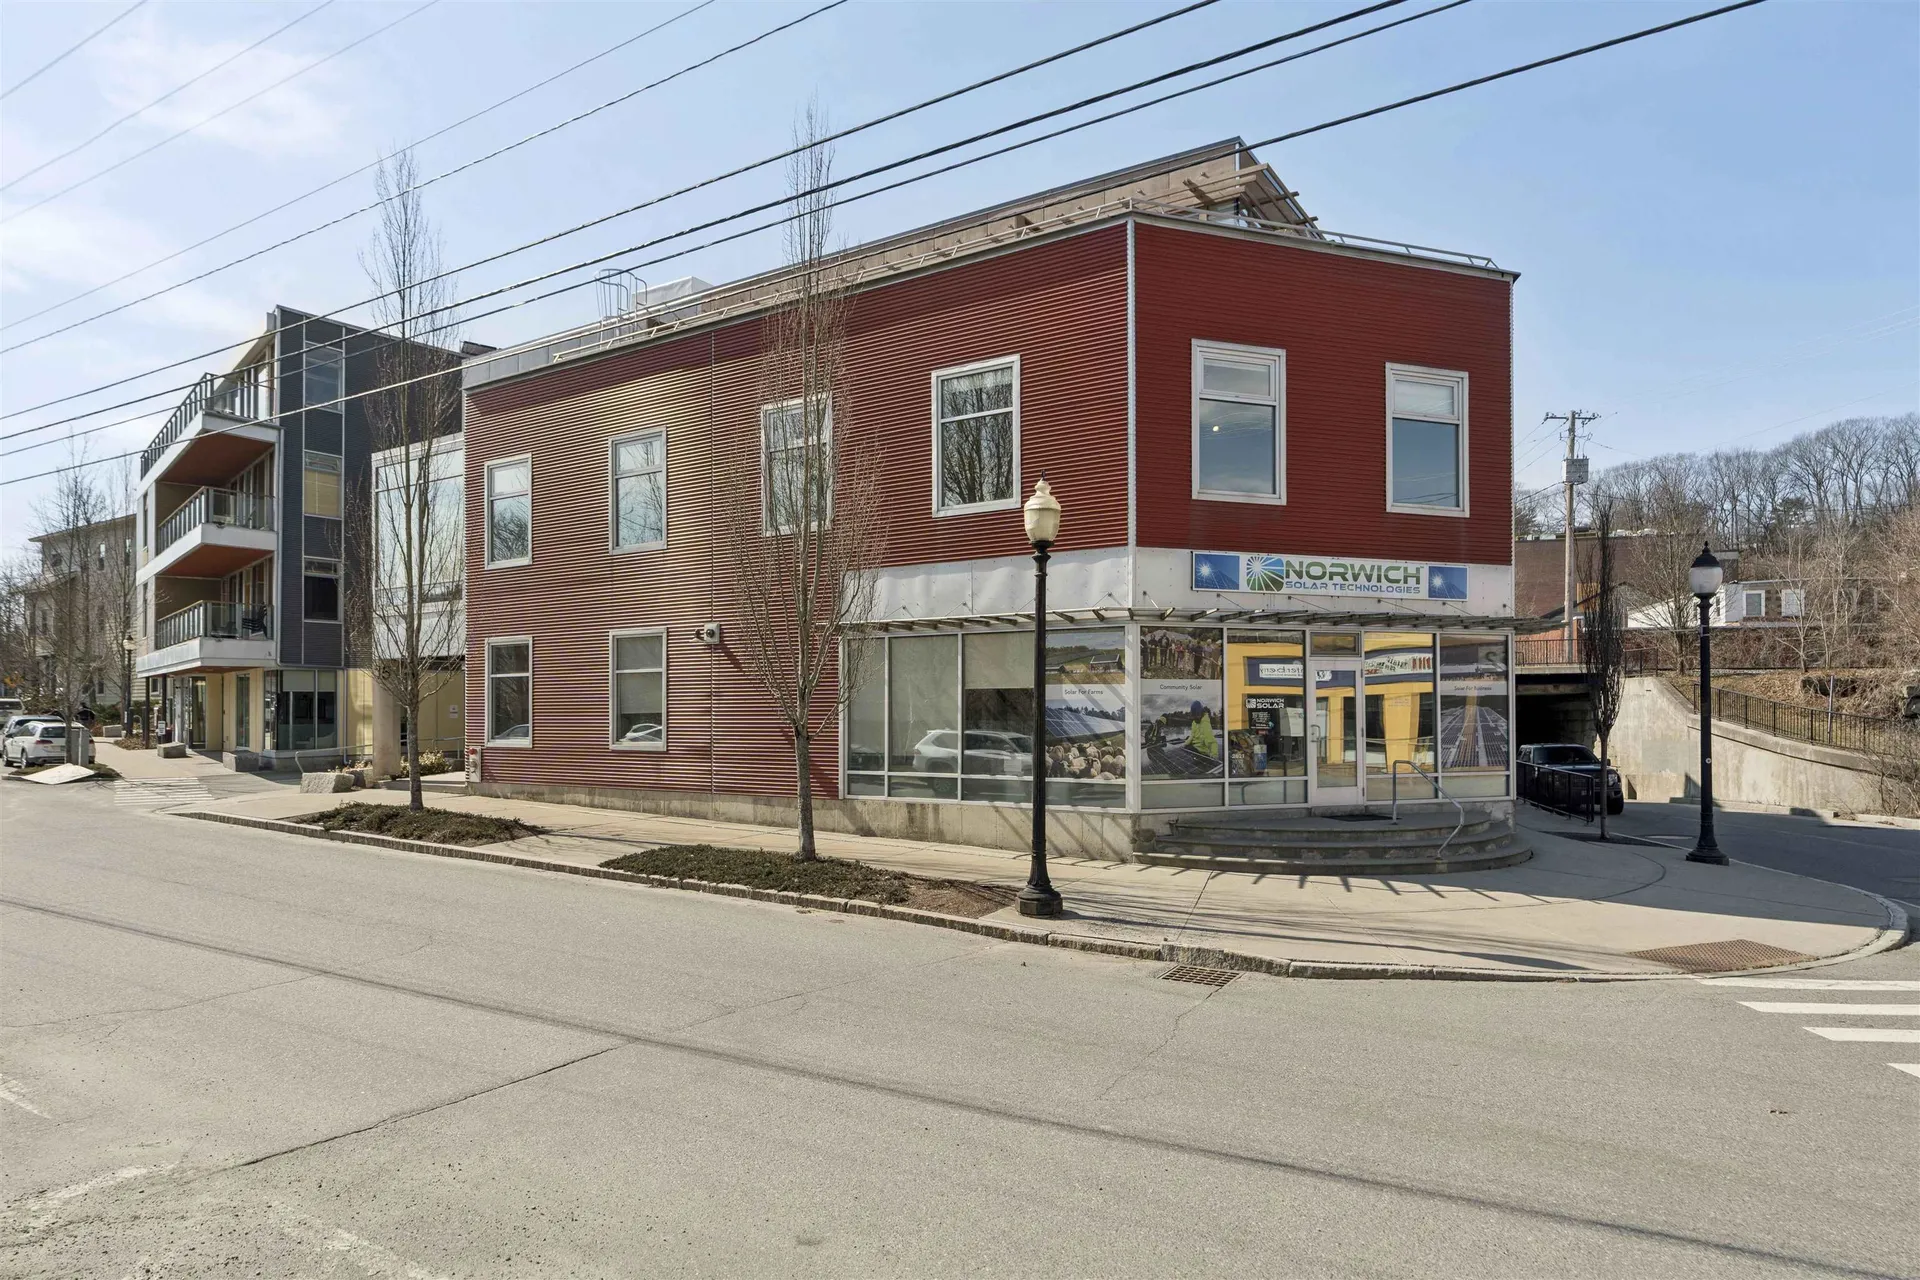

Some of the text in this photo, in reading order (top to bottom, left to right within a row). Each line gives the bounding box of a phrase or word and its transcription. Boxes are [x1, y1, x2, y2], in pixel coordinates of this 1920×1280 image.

[1285, 559, 1421, 585] NORWICH
[1285, 580, 1421, 594] SOLAR TECHNOLOGIES
